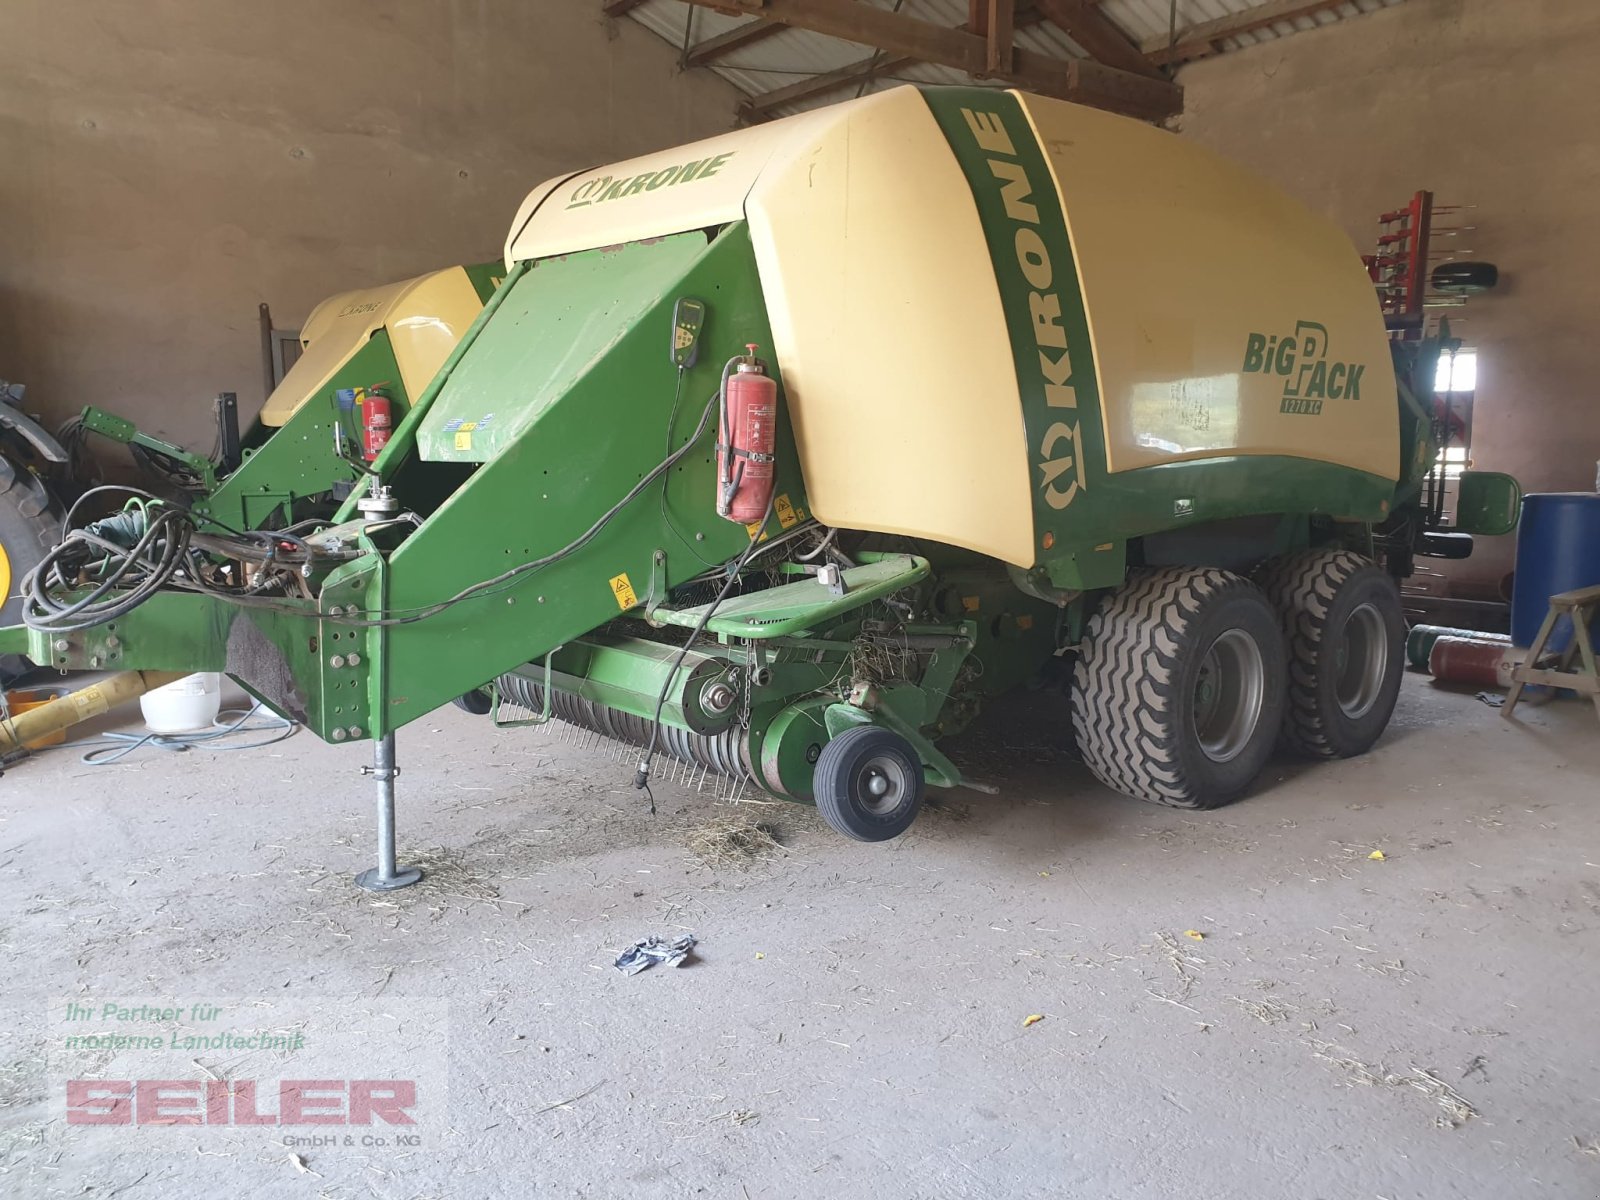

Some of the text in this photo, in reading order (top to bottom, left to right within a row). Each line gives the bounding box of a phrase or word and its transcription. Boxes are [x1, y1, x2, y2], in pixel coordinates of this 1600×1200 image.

[595, 151, 735, 203] KRONE
[960, 107, 1078, 409] KRONE
[1284, 400, 1321, 414] 1270 XC
